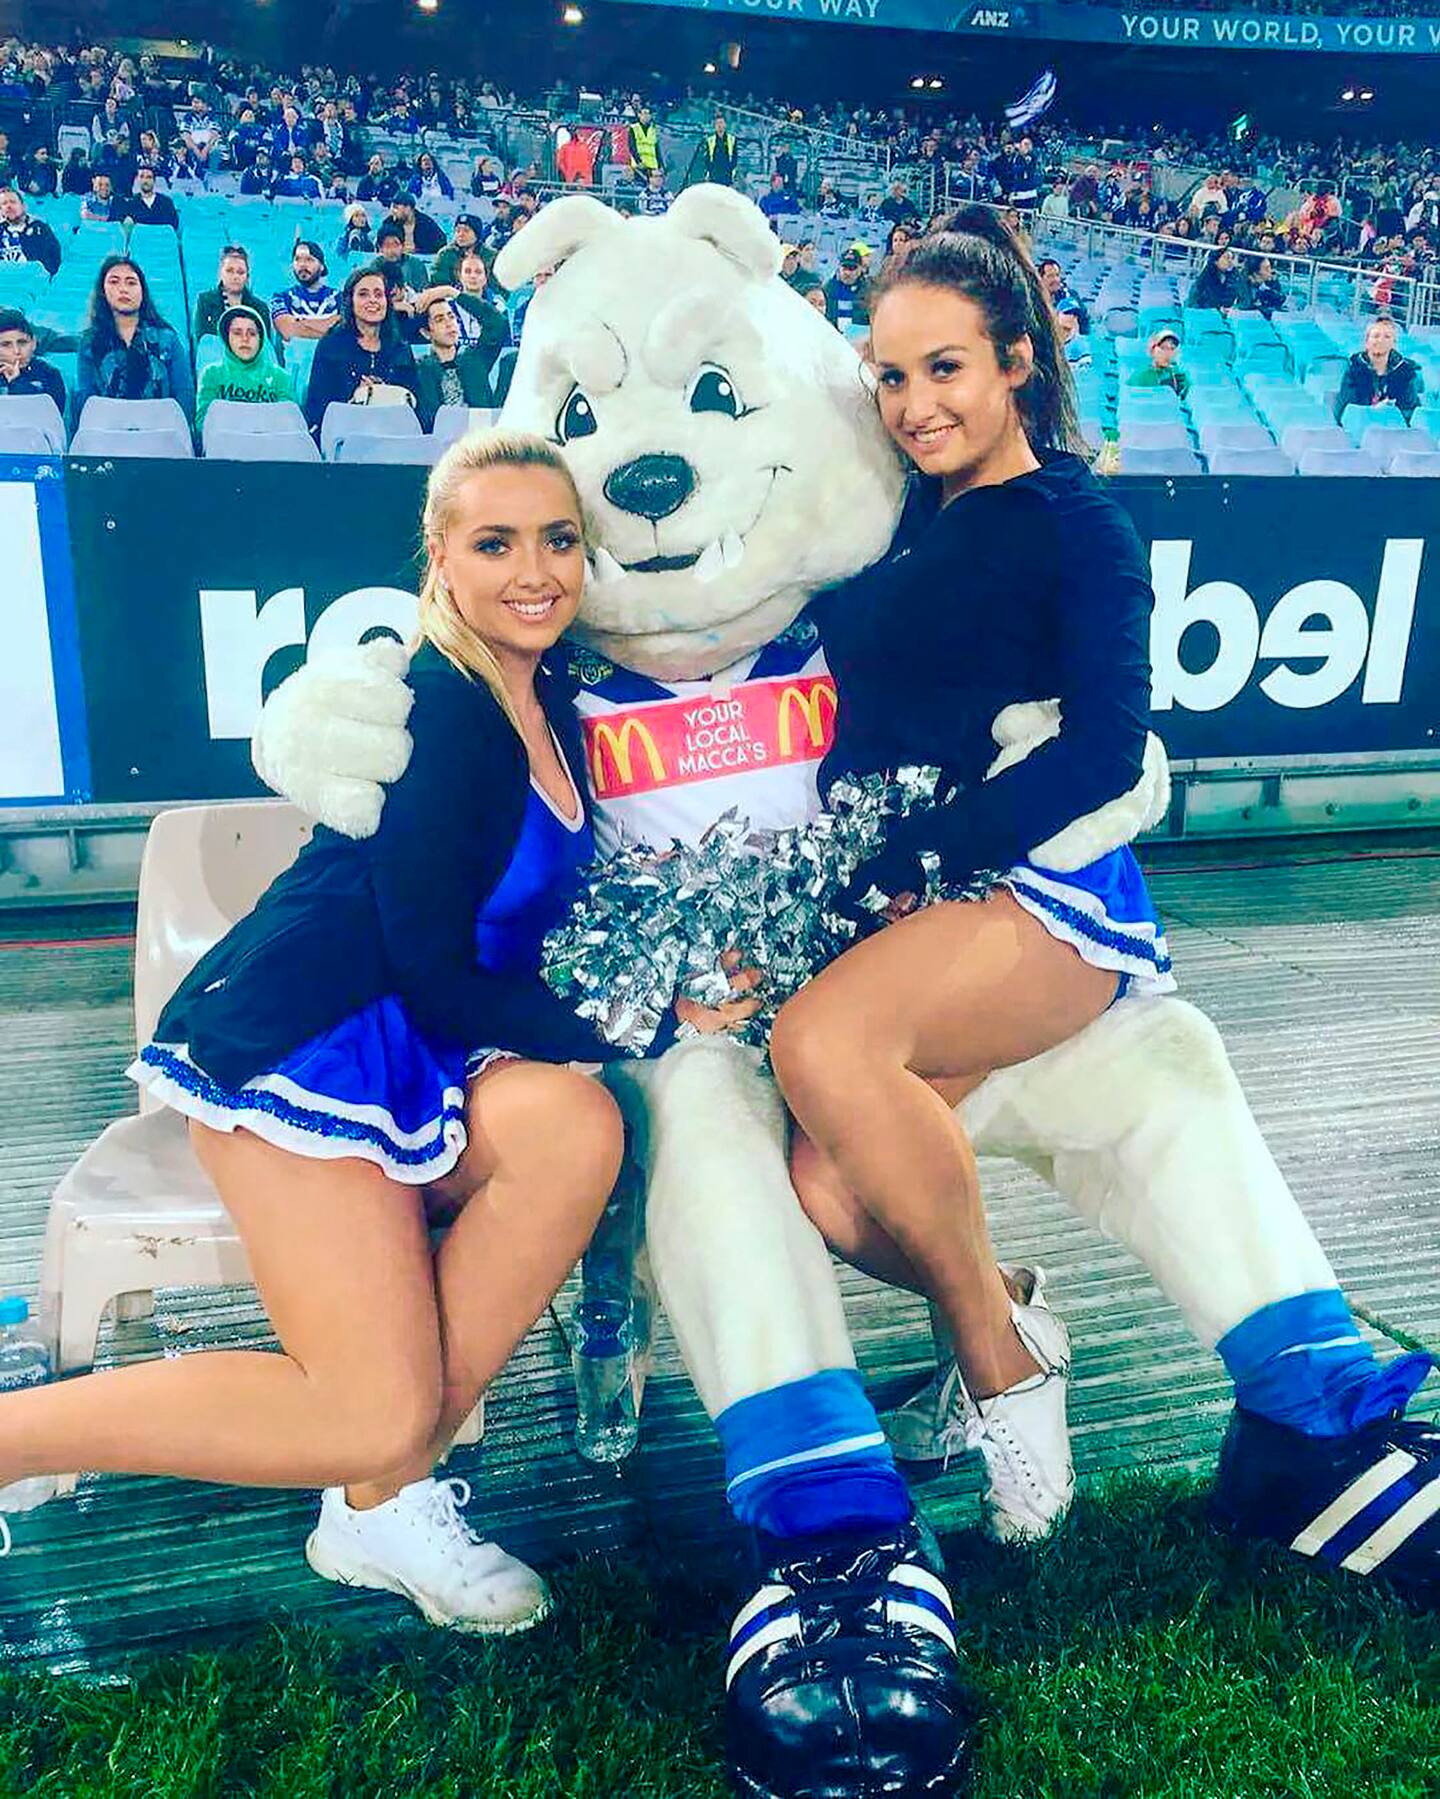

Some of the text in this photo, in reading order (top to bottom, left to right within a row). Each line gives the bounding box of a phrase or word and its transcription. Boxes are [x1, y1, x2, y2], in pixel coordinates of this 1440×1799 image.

[820, 0, 879, 18] WAY
[971, 10, 1009, 27] ANZ
[1121, 15, 1200, 40] YOUR
[1336, 23, 1415, 46] YOUR
[682, 701, 744, 729] YOUR
[685, 723, 750, 751] LOCAL
[678, 742, 767, 776] MACCA'S
